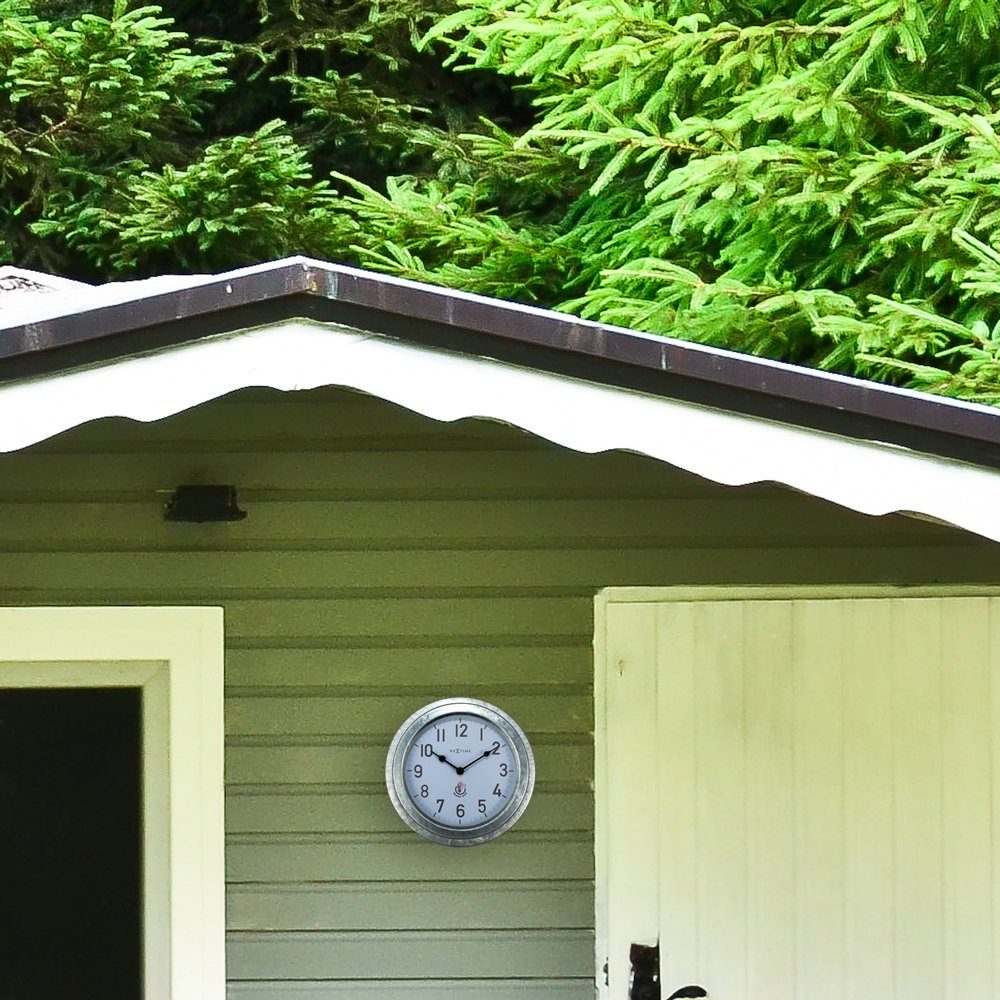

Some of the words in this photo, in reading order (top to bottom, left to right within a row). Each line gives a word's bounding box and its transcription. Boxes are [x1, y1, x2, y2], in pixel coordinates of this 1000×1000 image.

[437, 728, 445, 742] 11
[455, 723, 468, 738] 12
[480, 728, 483, 741] 1
[421, 743, 433, 757] 10
[492, 741, 501, 755] 2
[414, 764, 423, 778] 9
[499, 763, 508, 777] 3
[420, 784, 429, 798] 8
[492, 783, 502, 797] 4
[436, 799, 445, 813] 7
[456, 804, 465, 818] 6
[478, 799, 486, 813] 5
